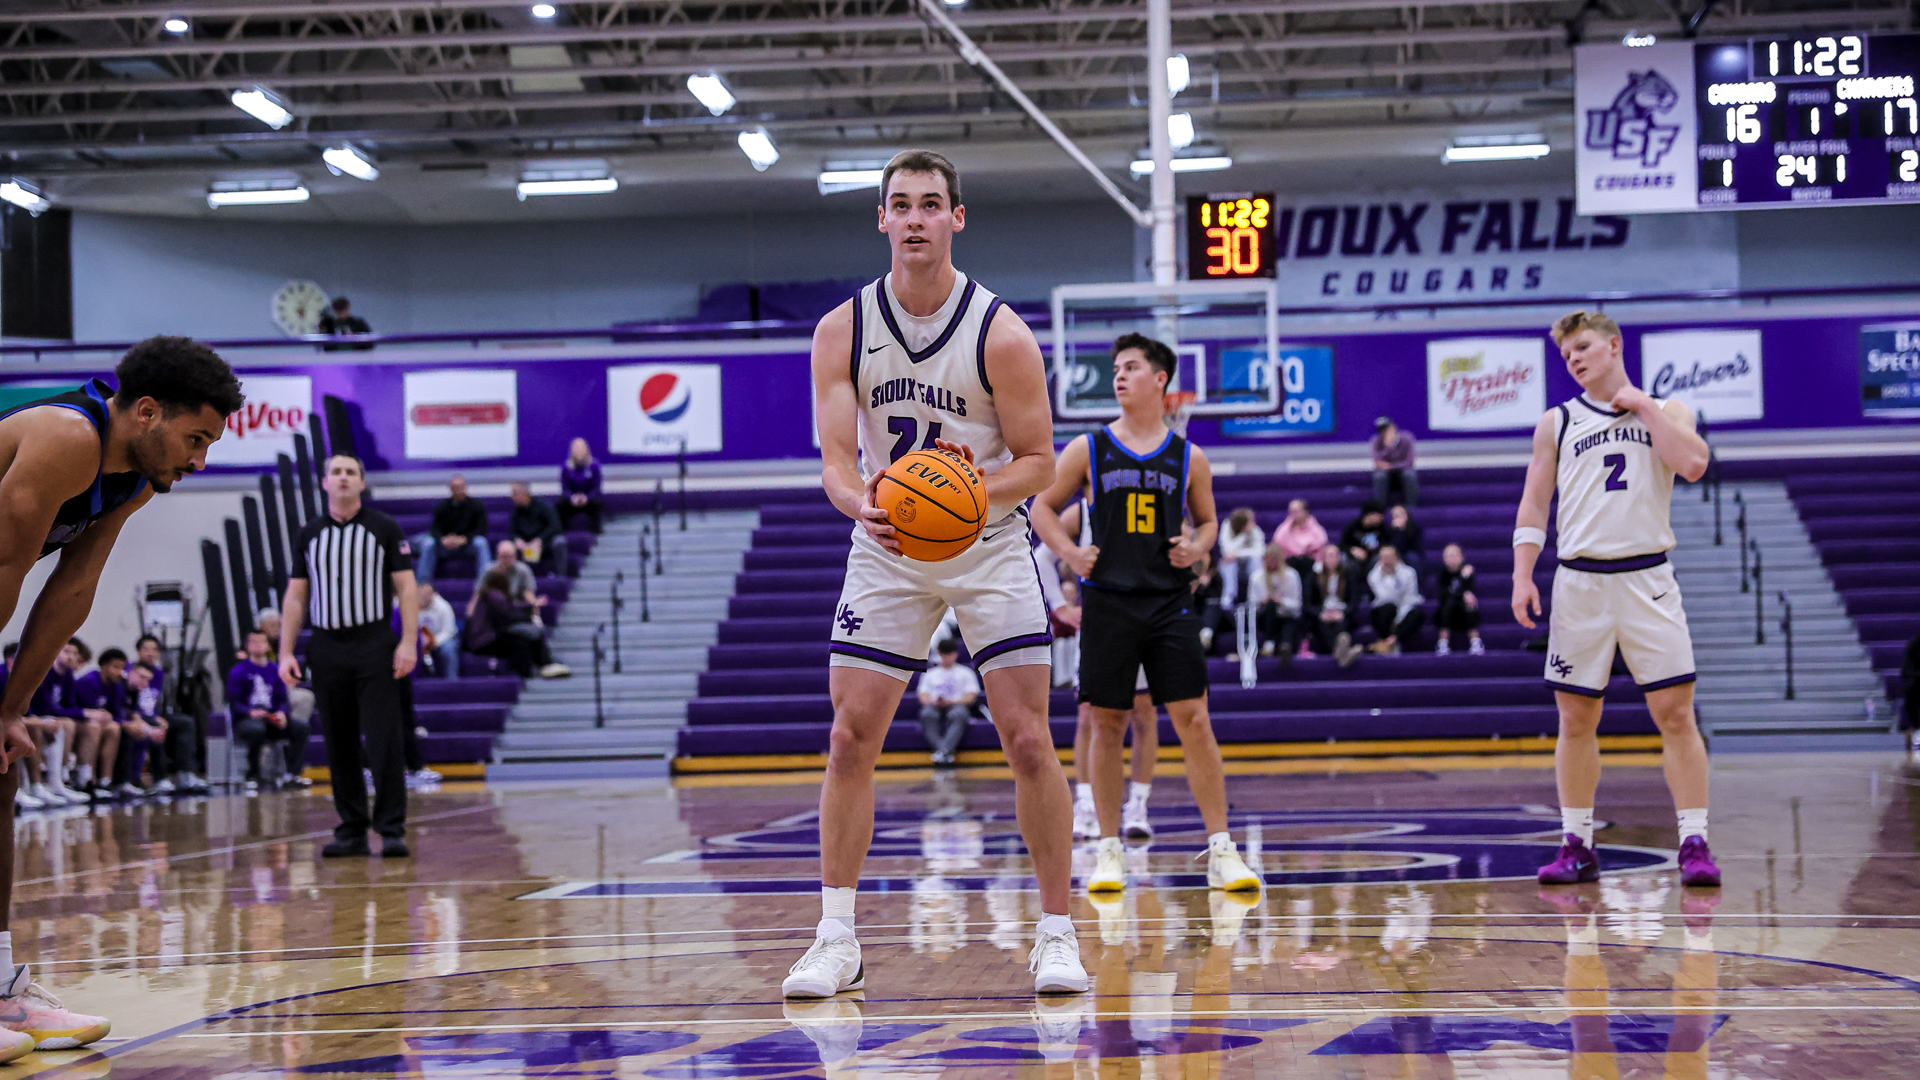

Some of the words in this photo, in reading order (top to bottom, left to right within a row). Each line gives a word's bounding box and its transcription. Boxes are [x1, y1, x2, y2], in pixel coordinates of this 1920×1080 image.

[1769, 36, 1862, 77] 11:22
[1726, 104, 1761, 144] 16
[1810, 107, 1820, 135] 1
[1884, 98, 1918, 135] 17
[1586, 108, 1680, 168] USF
[1595, 173, 1676, 190] COUGARS
[1722, 159, 1732, 187] 1
[1776, 154, 1816, 187] 24
[1836, 154, 1846, 183] 1
[1899, 150, 1919, 182] 2
[1201, 198, 1270, 229] 11:22
[1276, 202, 1429, 259] IOUX
[1440, 198, 1631, 254] FALLS
[1206, 227, 1260, 275] 30
[1322, 265, 1543, 295] COUGARS
[871, 377, 916, 409] SIOUX
[917, 382, 967, 417] FALLS
[1574, 428, 1610, 458] SIOUX
[1615, 427, 1653, 448] FALLS
[905, 461, 951, 490] EVO
[1101, 469, 1141, 494] BRIAR
[1144, 469, 1178, 495] CLIFF
[1603, 453, 1628, 492] 2
[1126, 492, 1155, 534] 15
[836, 602, 865, 637] USF
[1550, 653, 1574, 679] USF
